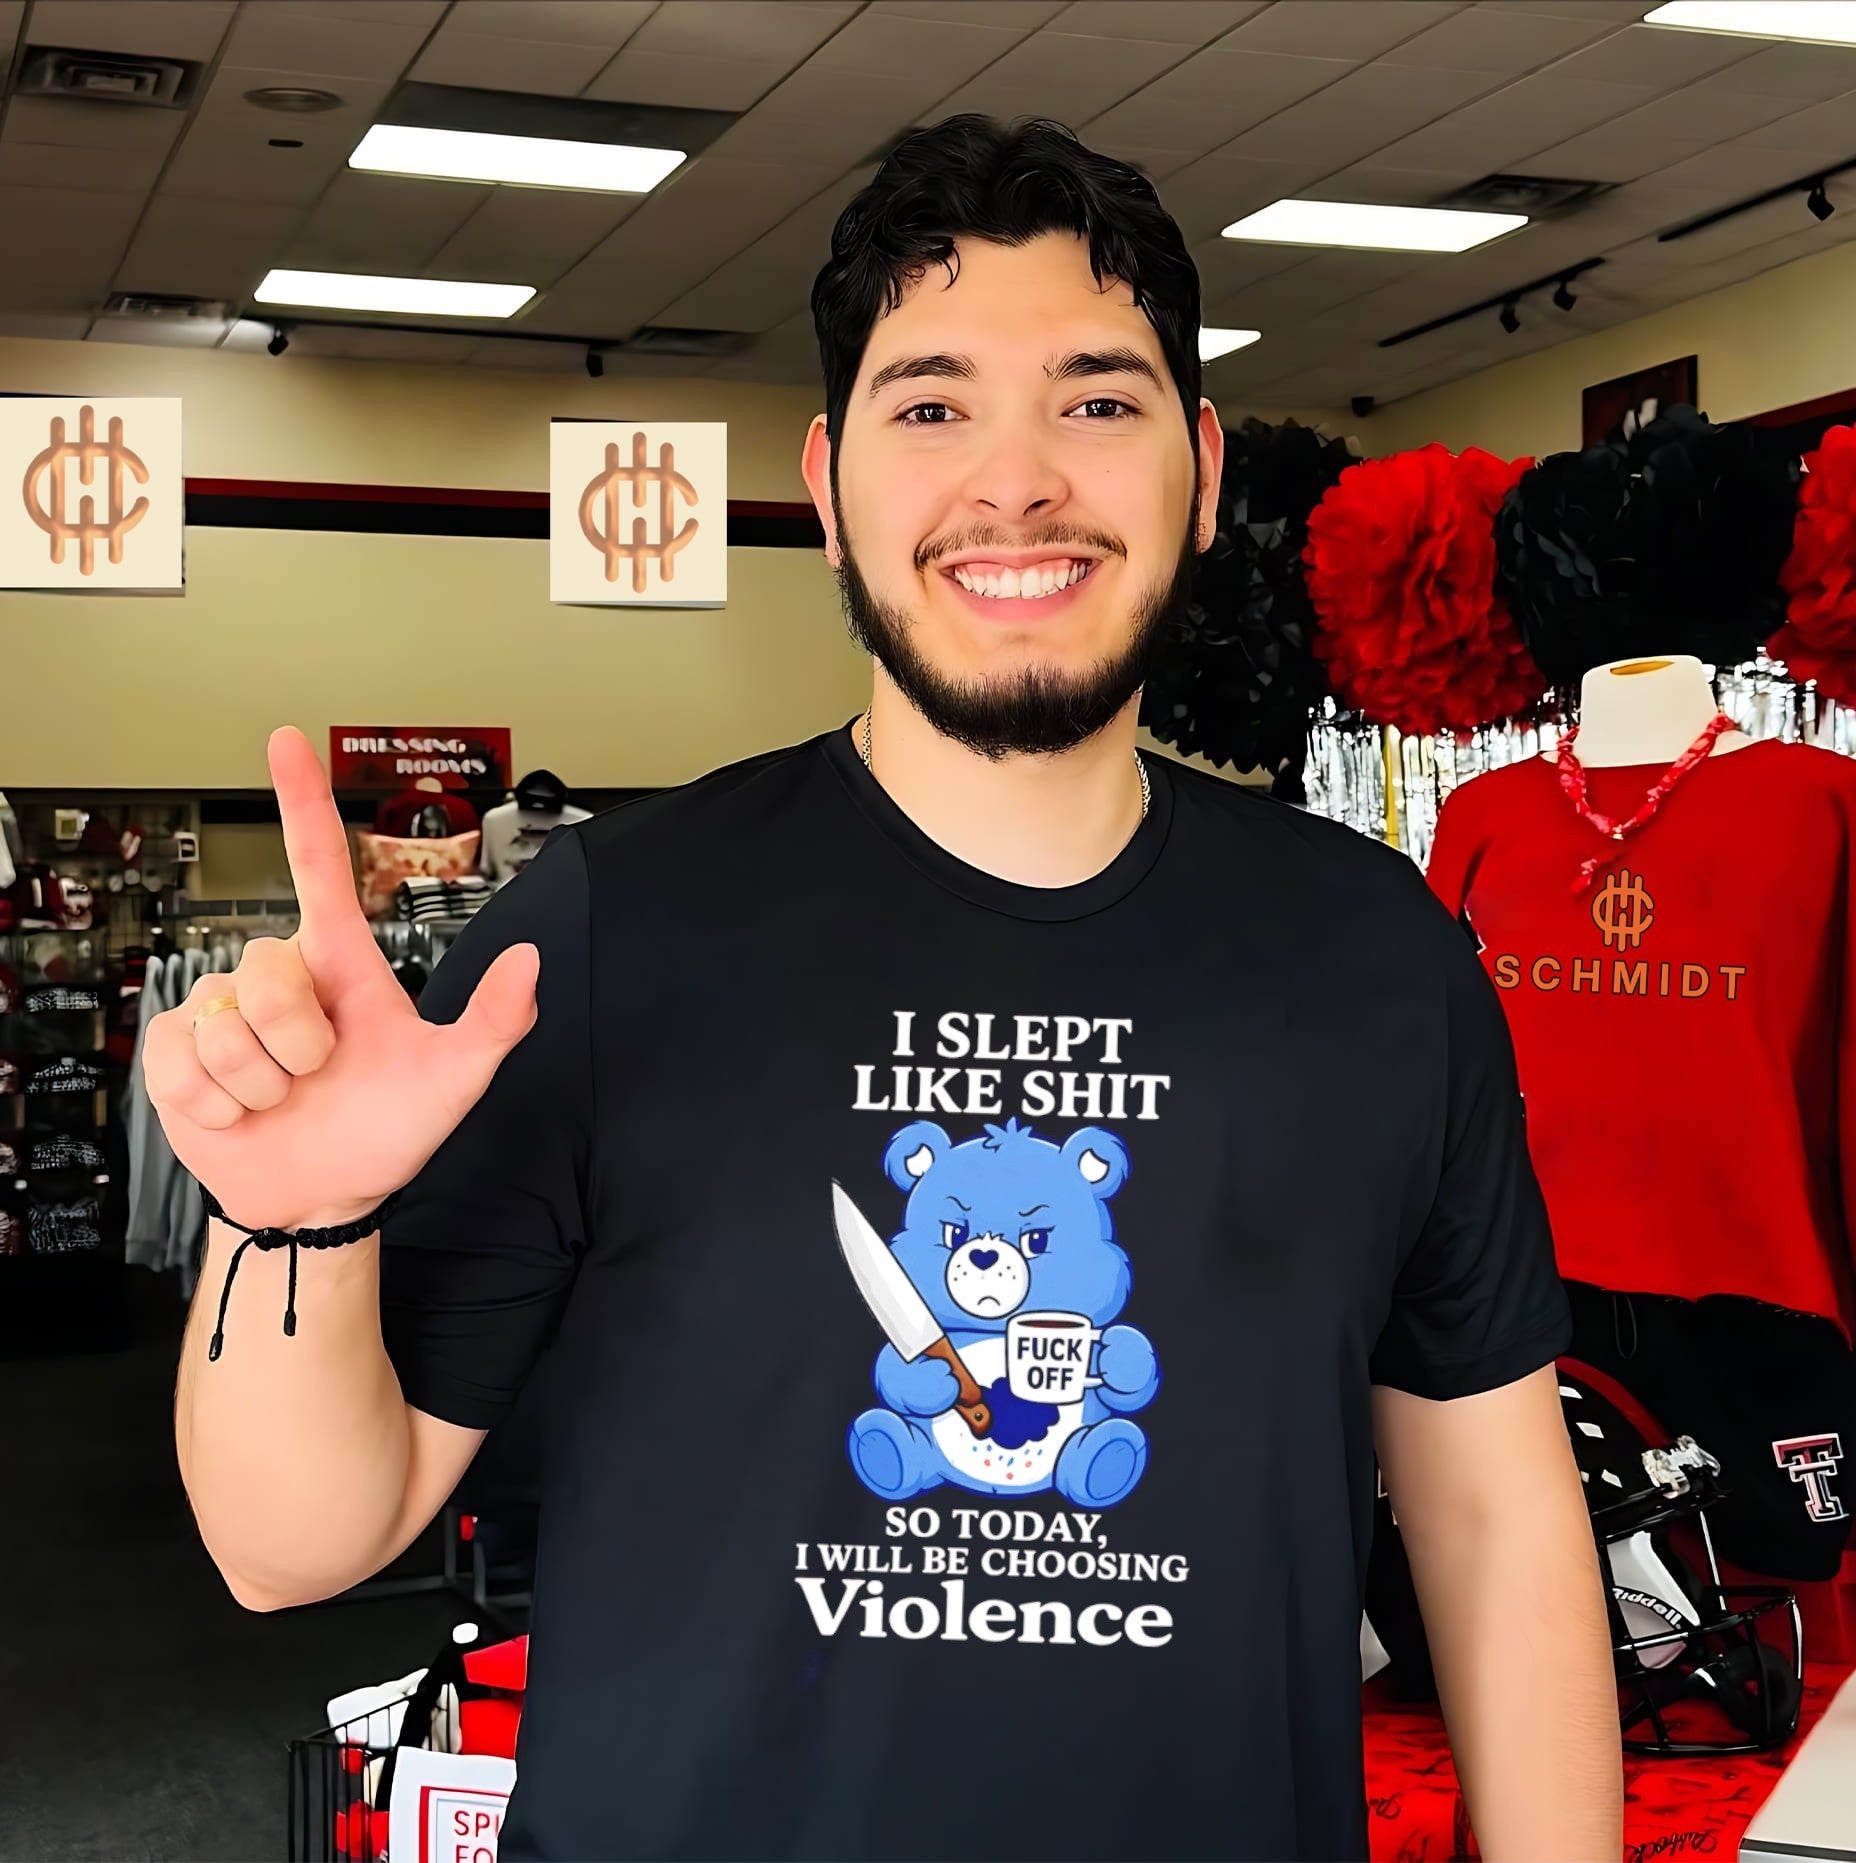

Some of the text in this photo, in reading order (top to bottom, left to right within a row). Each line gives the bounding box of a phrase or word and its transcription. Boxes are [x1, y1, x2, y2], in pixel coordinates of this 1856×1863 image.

[396, 758, 487, 774] ROOMS
[1494, 955, 1746, 1000] SCHMIDT
[893, 1010, 1133, 1064] I SLEPT
[851, 1064, 1171, 1120] LIKE SHIT
[1017, 1337, 1083, 1362] FUCK
[1027, 1366, 1074, 1391] OFF
[885, 1506, 1108, 1549] SO TODAY,
[795, 1542, 1190, 1583] I WILL BE CHOOSING
[794, 1576, 1174, 1648] Violence
